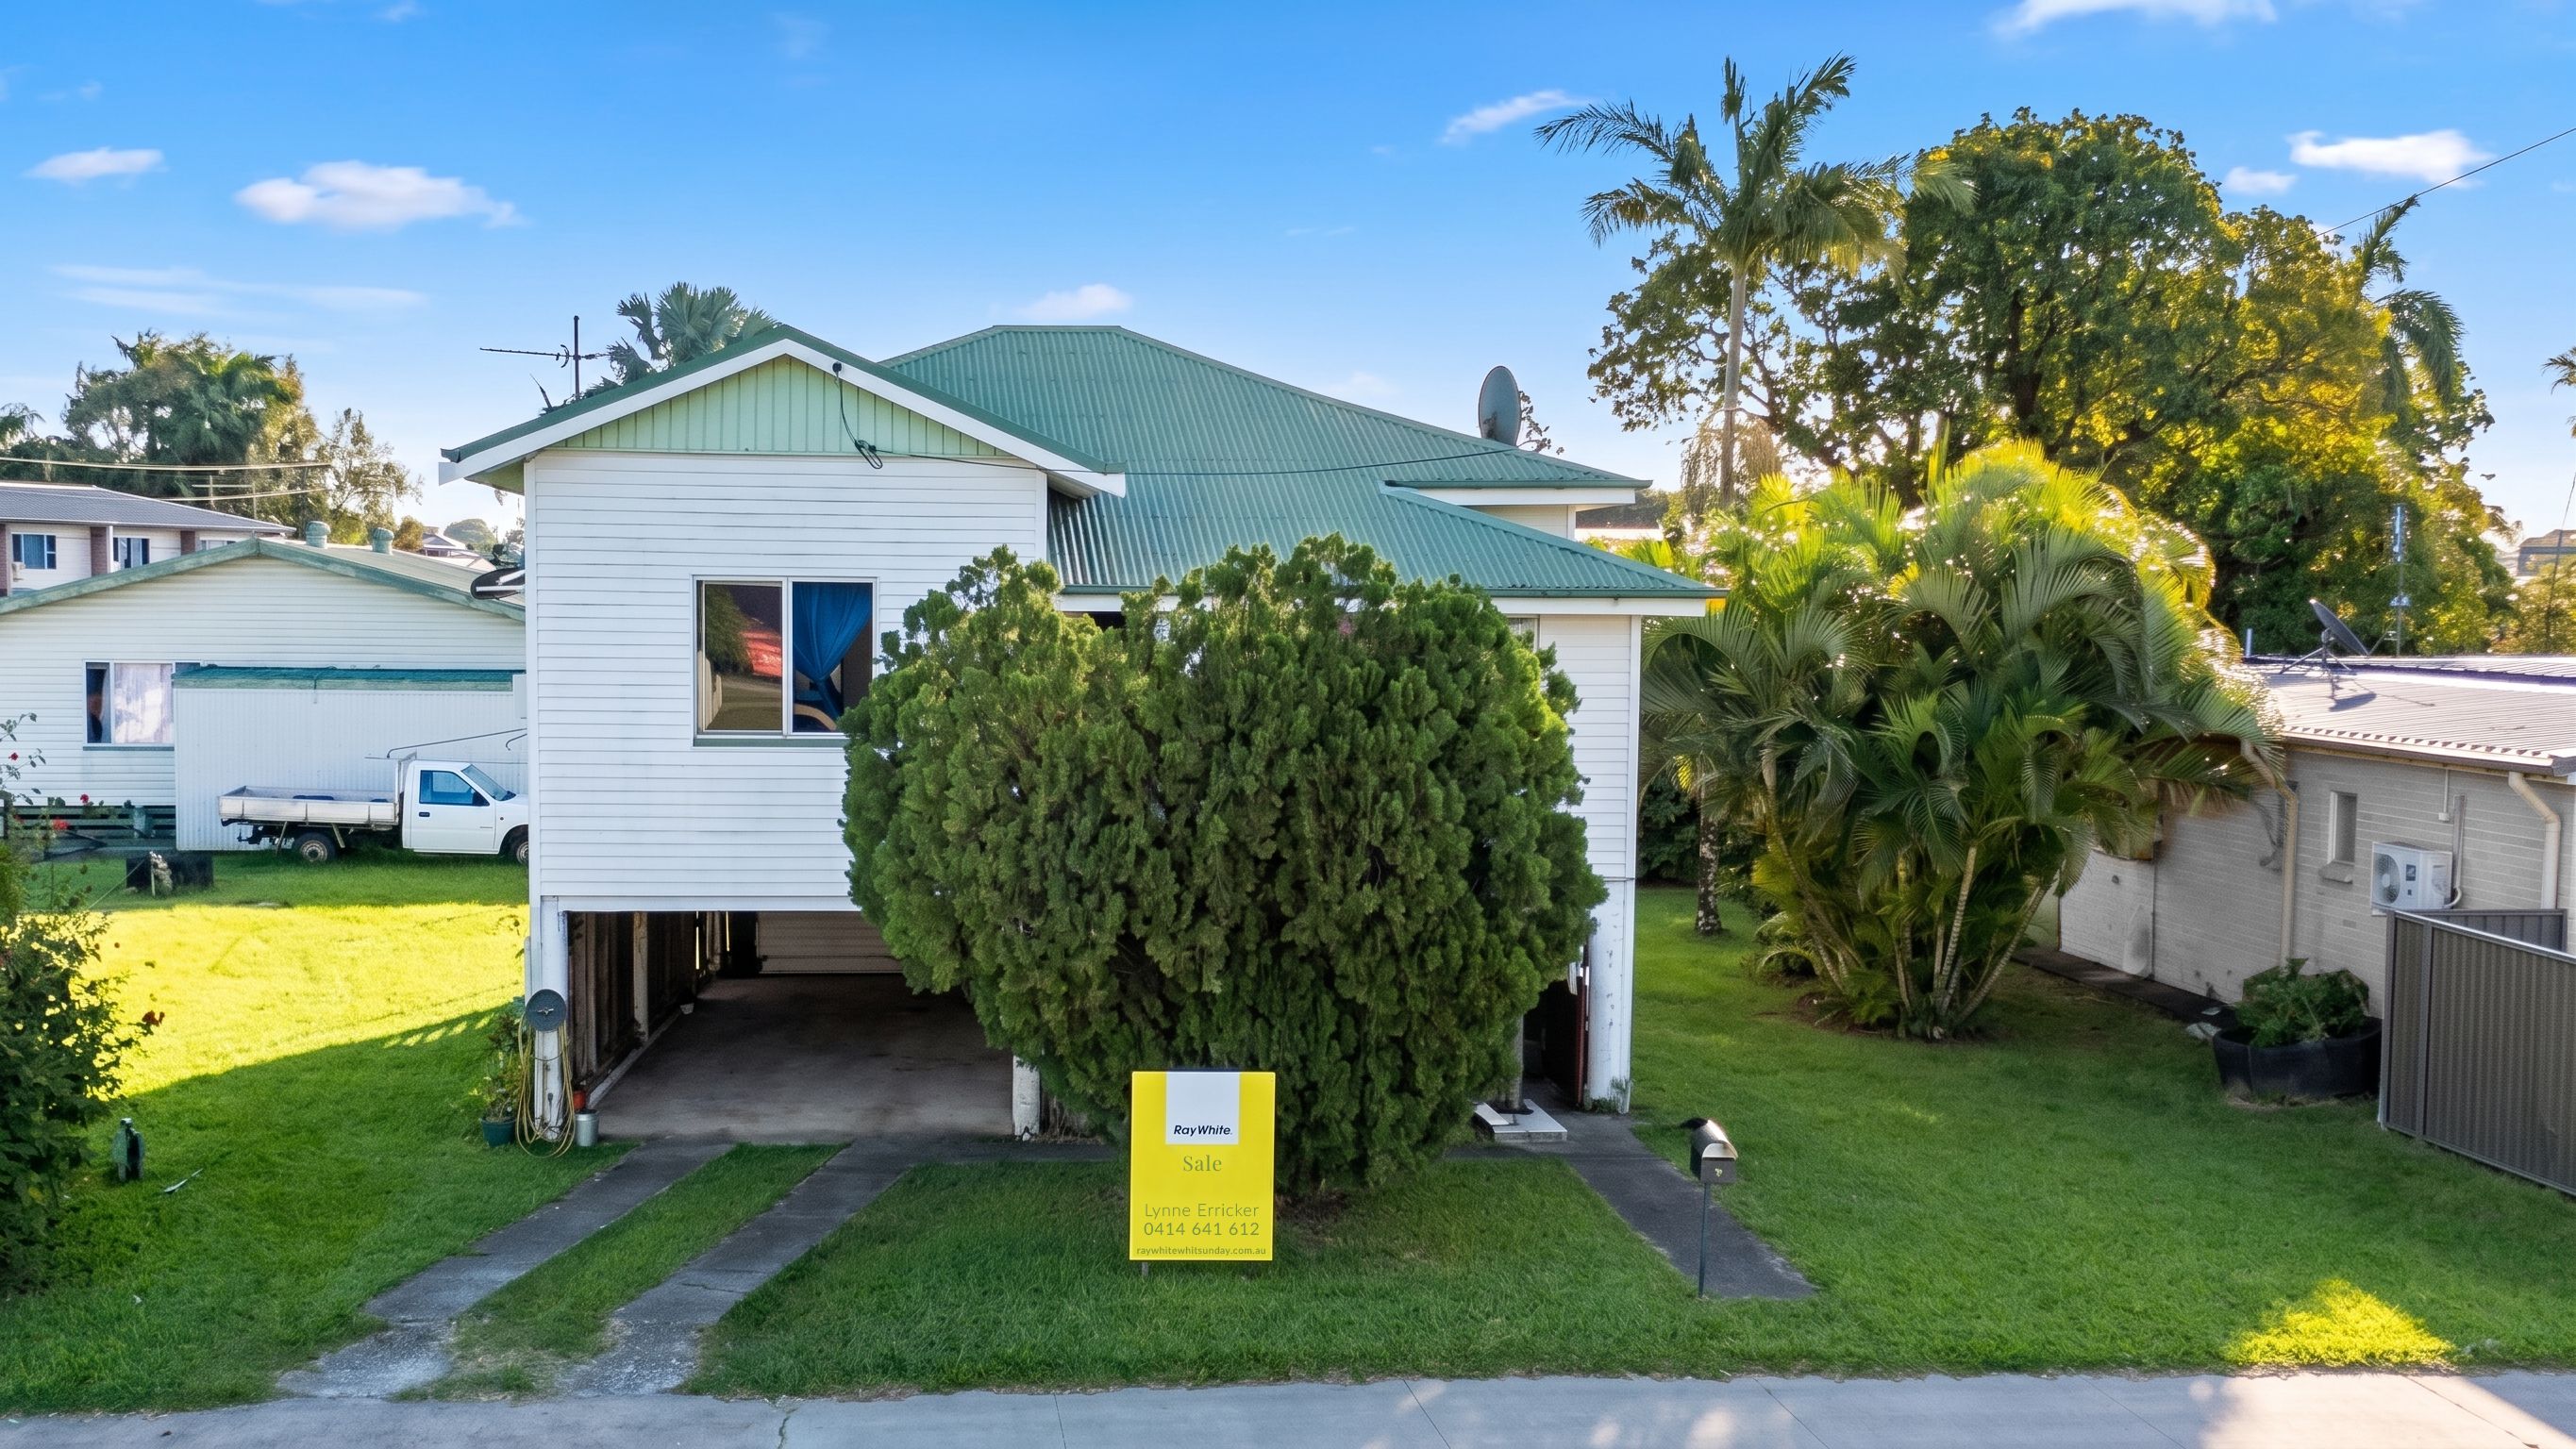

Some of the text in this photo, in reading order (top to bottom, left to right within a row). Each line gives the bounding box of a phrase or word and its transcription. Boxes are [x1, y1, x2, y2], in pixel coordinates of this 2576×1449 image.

[1183, 1155, 1222, 1172] Sale
[1145, 1203, 1259, 1219] Lynne Erricker
[1144, 1223, 1259, 1236] 0414 641 612
[1136, 1245, 1266, 1256] raywhitewhitsunday.com.au
